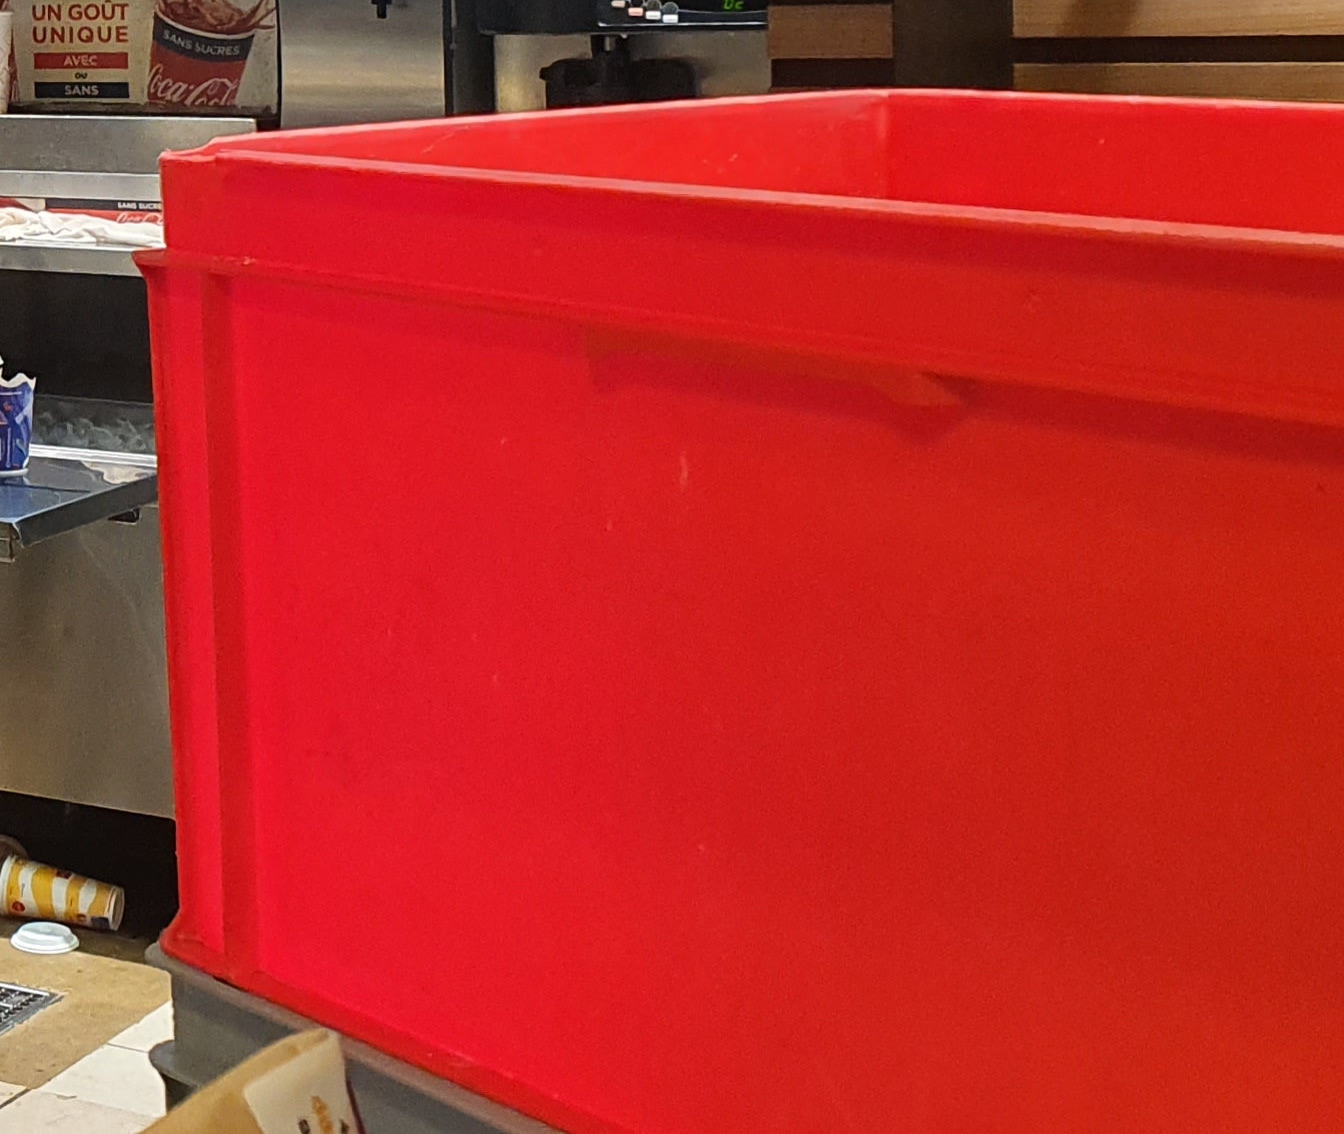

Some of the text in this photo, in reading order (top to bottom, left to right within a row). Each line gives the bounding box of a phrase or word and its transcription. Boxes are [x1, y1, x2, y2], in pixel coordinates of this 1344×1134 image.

[32, 0, 129, 21] UN GOÛT
[32, 25, 129, 44] UNIQUE
[163, 29, 241, 56] SANS SUCRES
[63, 55, 98, 66] AVEC
[75, 71, 88, 80] OU
[64, 84, 99, 96] SANS
